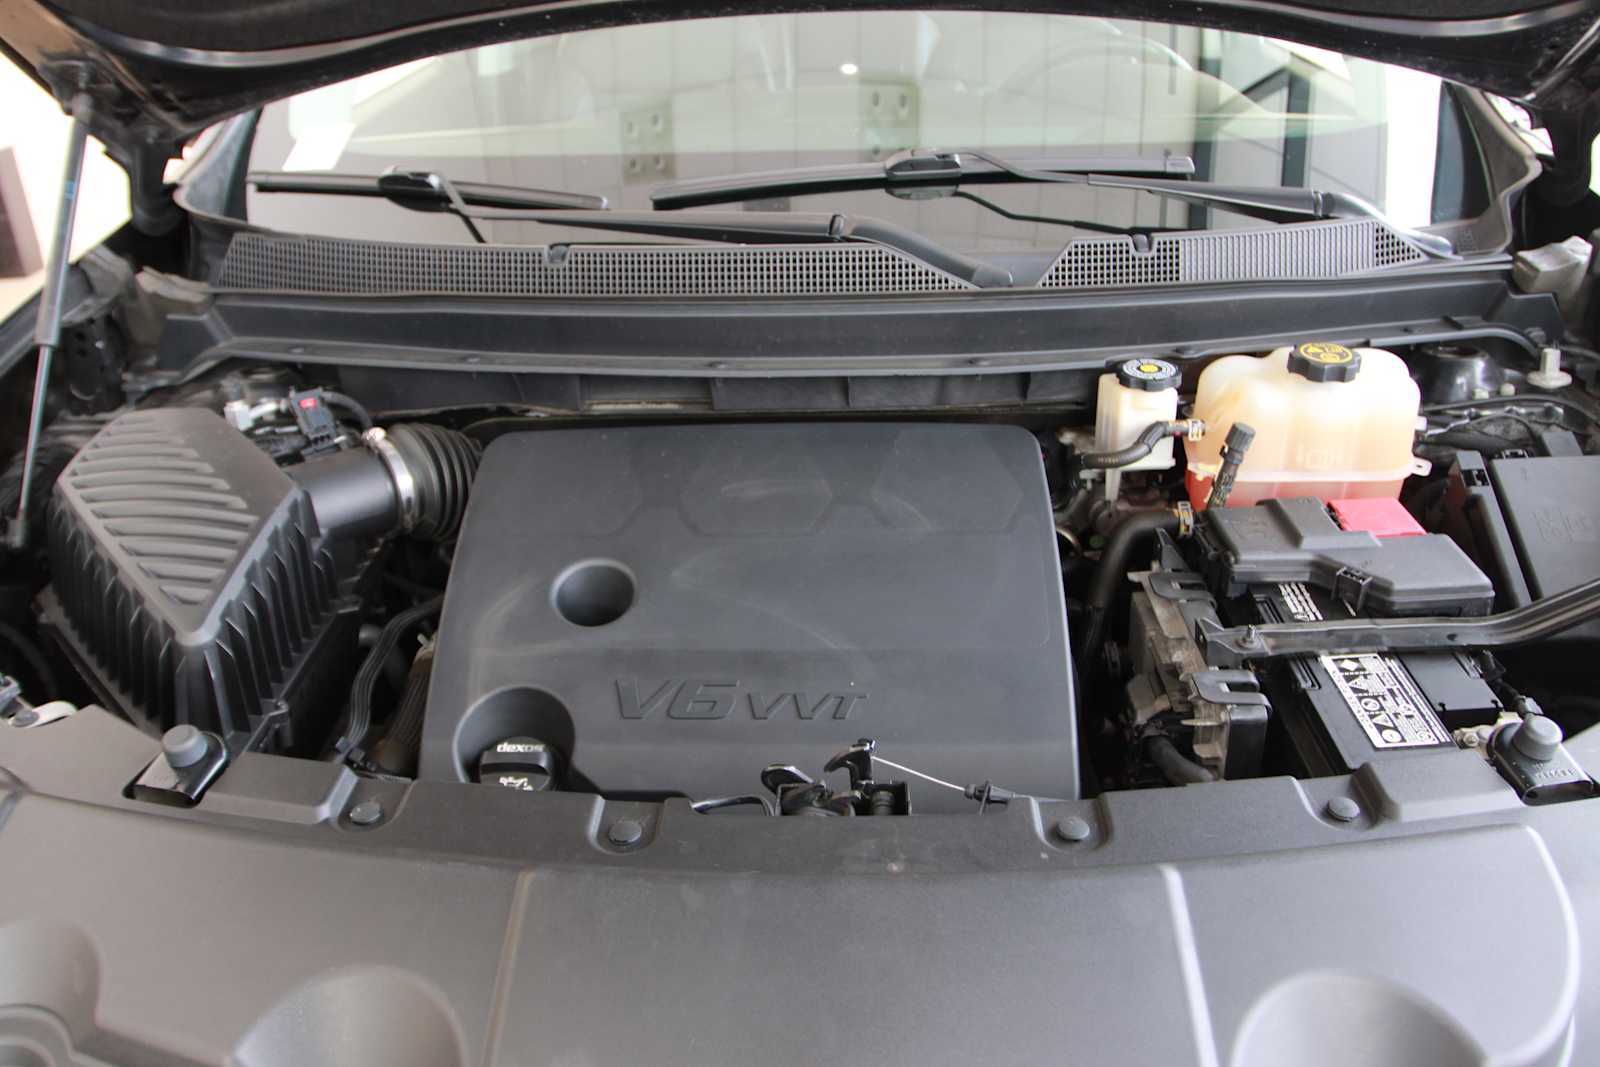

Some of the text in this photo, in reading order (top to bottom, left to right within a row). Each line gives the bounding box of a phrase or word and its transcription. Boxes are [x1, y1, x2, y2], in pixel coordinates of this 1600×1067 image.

[614, 678, 870, 721] V6 VVT
[496, 741, 546, 753] dexos
